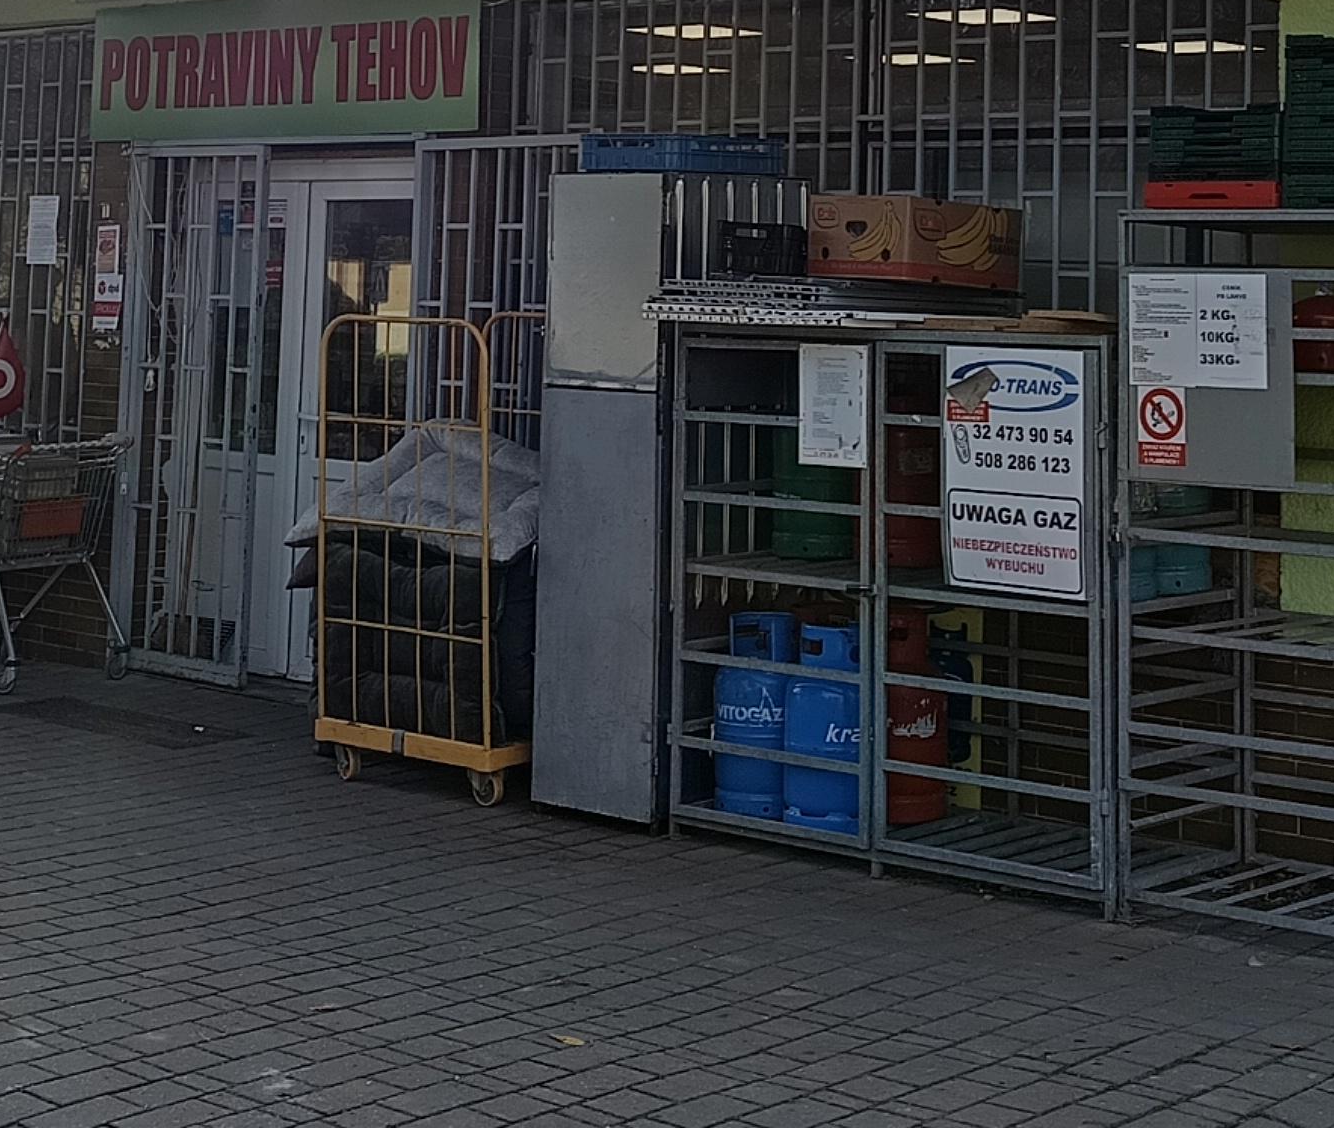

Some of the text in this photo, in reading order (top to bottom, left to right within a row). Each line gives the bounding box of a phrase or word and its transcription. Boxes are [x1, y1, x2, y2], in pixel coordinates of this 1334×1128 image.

[99, 14, 470, 111] POTRAVINY TEHOV
[1199, 308, 1207, 320] 2
[973, 424, 1074, 445] 32 473 90 54
[975, 452, 1070, 474] 508 286 123
[952, 503, 1077, 531] UWAGA GAZ
[953, 537, 1077, 560] NIEBEZPIECZEŃSTWO
[985, 557, 1045, 575] WYBUCHU
[717, 692, 784, 722] VITOGAZ
